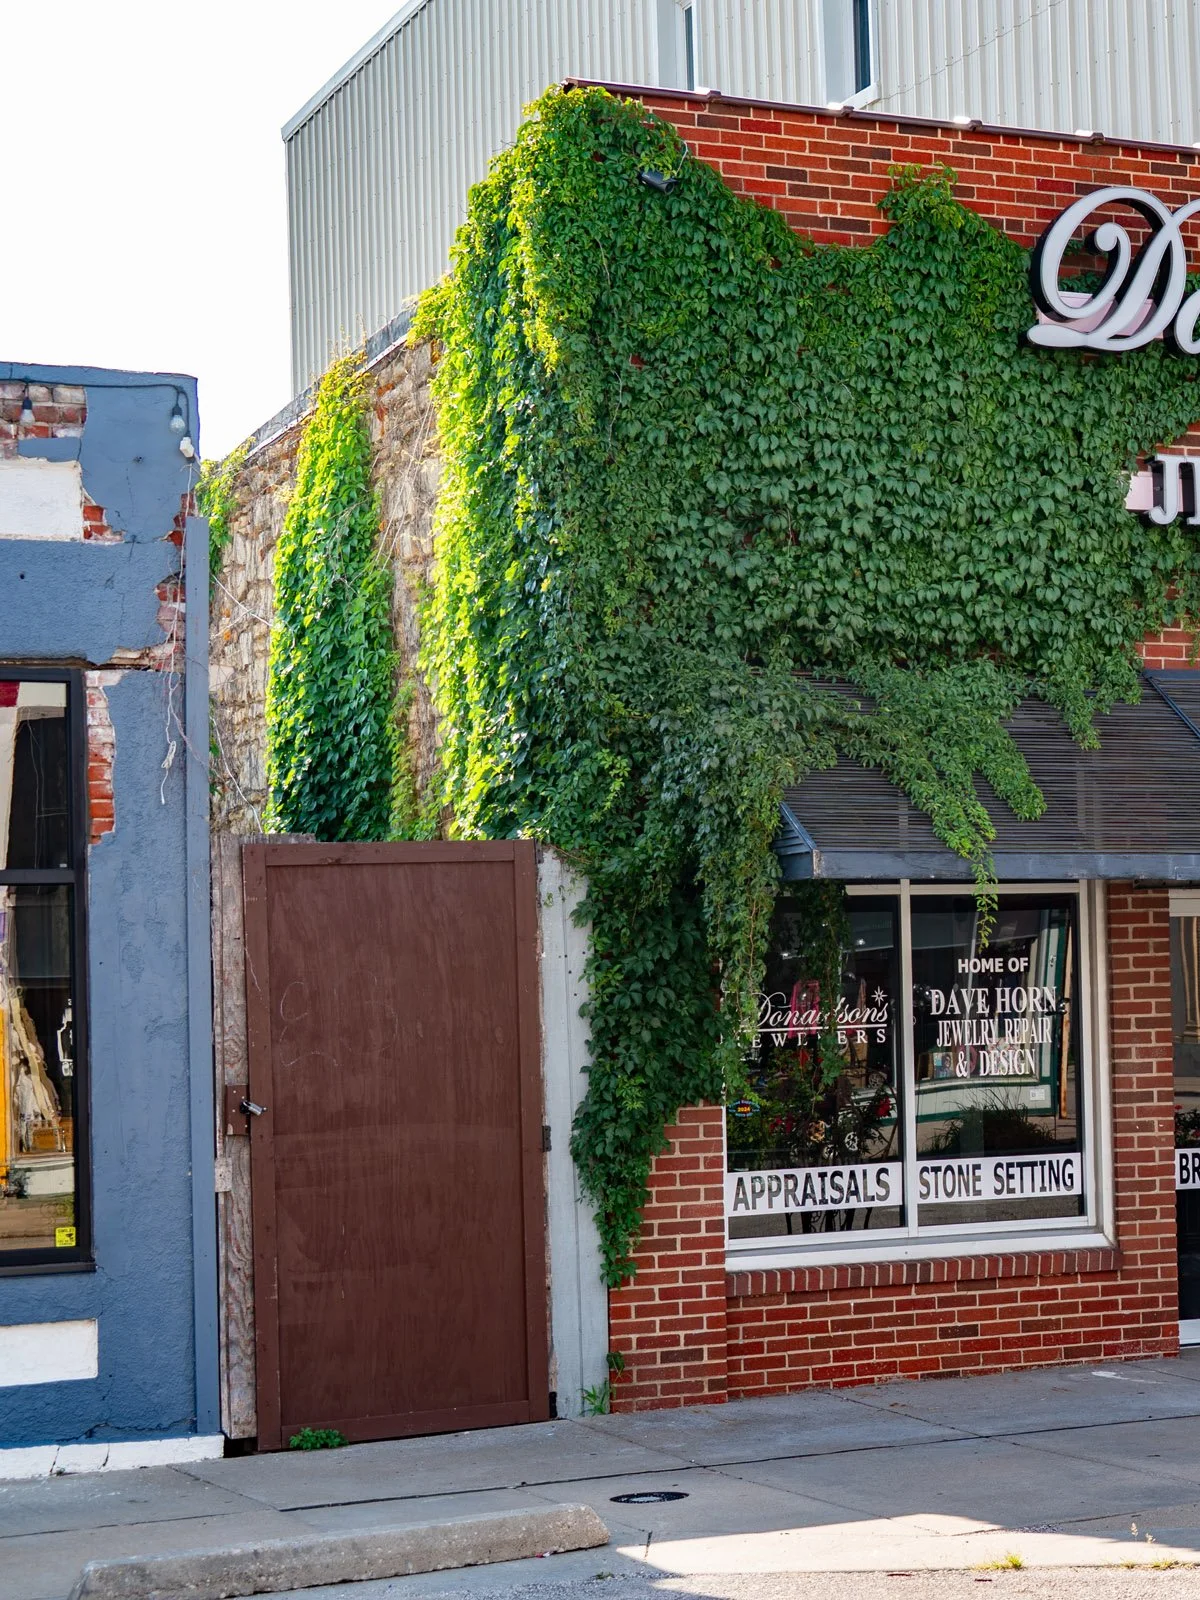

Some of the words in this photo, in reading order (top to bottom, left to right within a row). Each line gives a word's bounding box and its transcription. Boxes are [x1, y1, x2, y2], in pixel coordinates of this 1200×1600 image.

[957, 957, 1004, 974] HOME
[1007, 956, 1029, 972] OF
[930, 988, 990, 1016] DAVE
[995, 986, 1057, 1014] HORN
[936, 1018, 999, 1047] JEWELRY
[1004, 1017, 1053, 1045] REPAIR
[955, 1050, 969, 1078] &
[979, 1048, 1036, 1077] DESIGN
[733, 1166, 891, 1212] APPRAISALS
[918, 1164, 983, 1200] STONE
[993, 1157, 1075, 1196] SETTING
